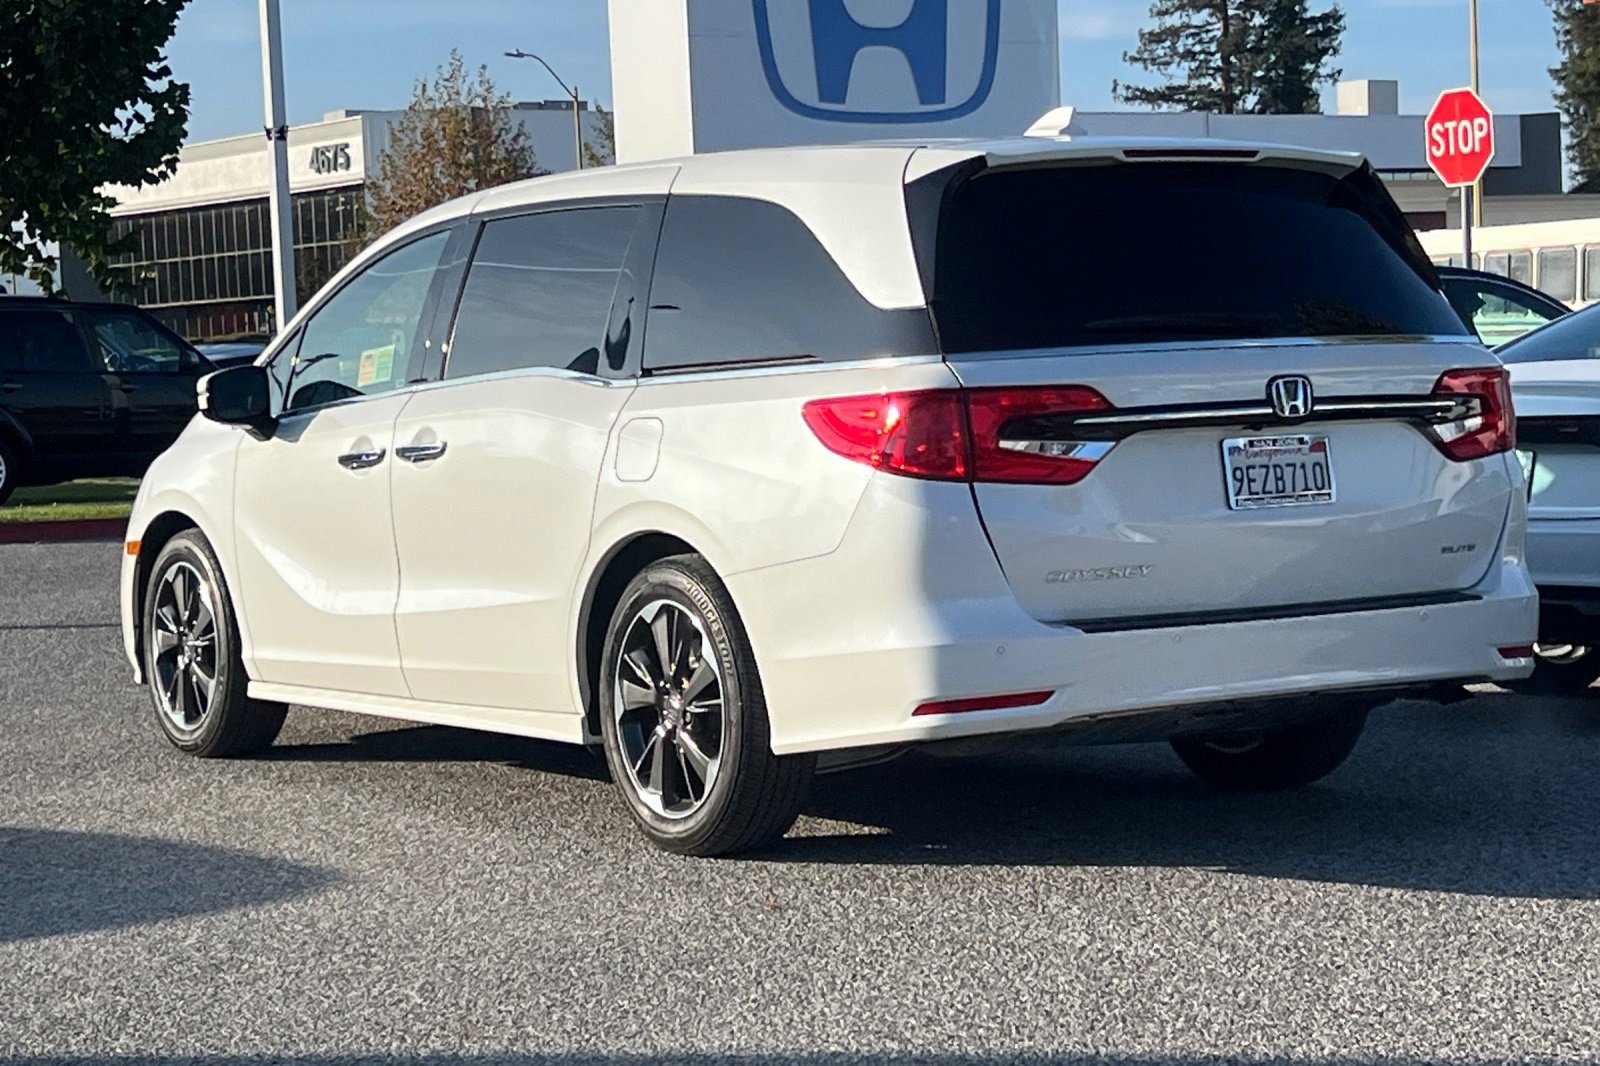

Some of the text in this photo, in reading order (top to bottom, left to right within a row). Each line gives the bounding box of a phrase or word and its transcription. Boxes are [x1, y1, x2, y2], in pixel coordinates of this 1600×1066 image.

[1430, 117, 1488, 158] STOP
[309, 142, 351, 174] 4675
[1253, 438, 1274, 447] SAN
[1232, 461, 1326, 497] 9EZB710
[1045, 564, 1153, 584] ODYSSEY
